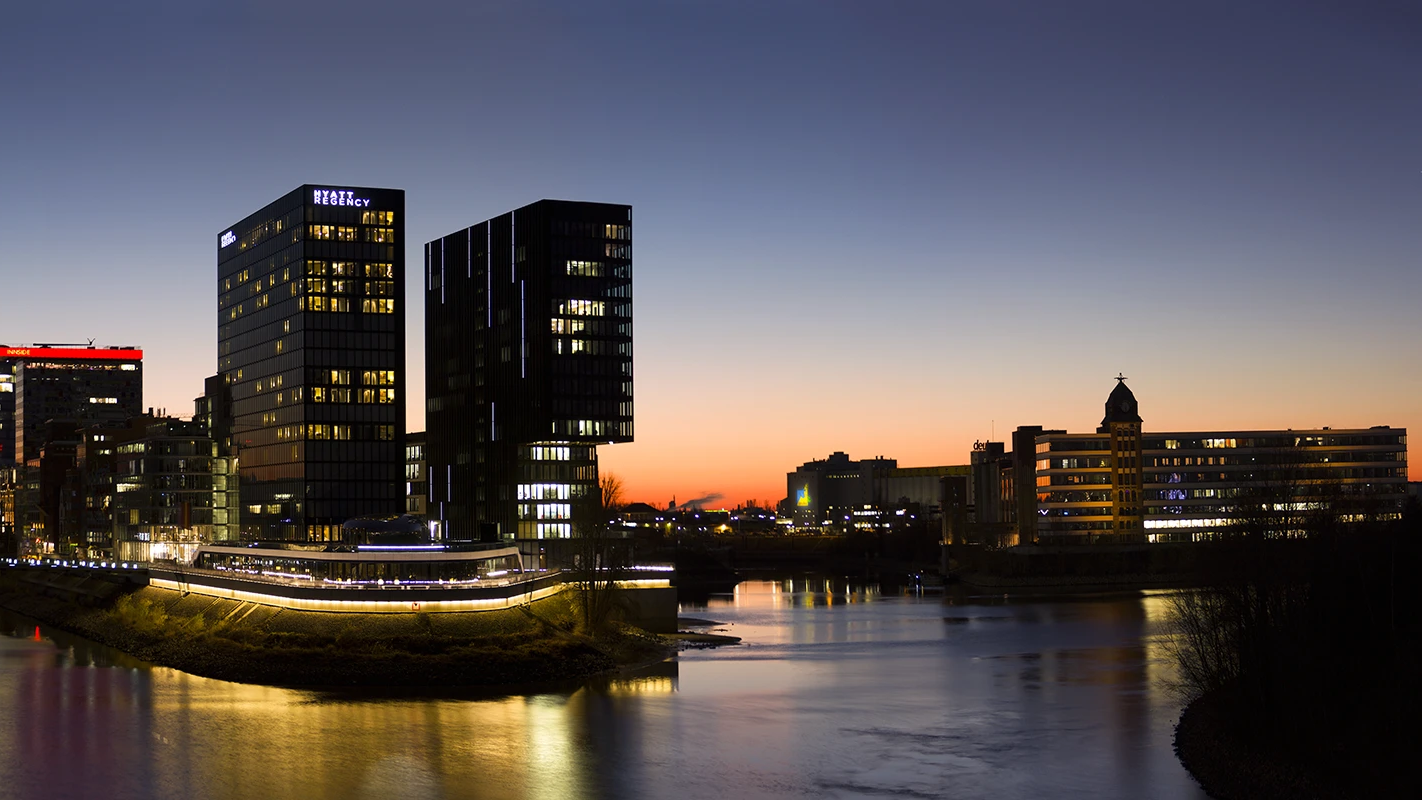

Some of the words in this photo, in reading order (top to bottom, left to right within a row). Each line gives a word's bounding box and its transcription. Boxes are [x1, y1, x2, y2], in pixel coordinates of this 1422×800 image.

[314, 189, 354, 199] HYATT
[314, 197, 370, 207] REGENCY
[973, 439, 990, 450] deu
